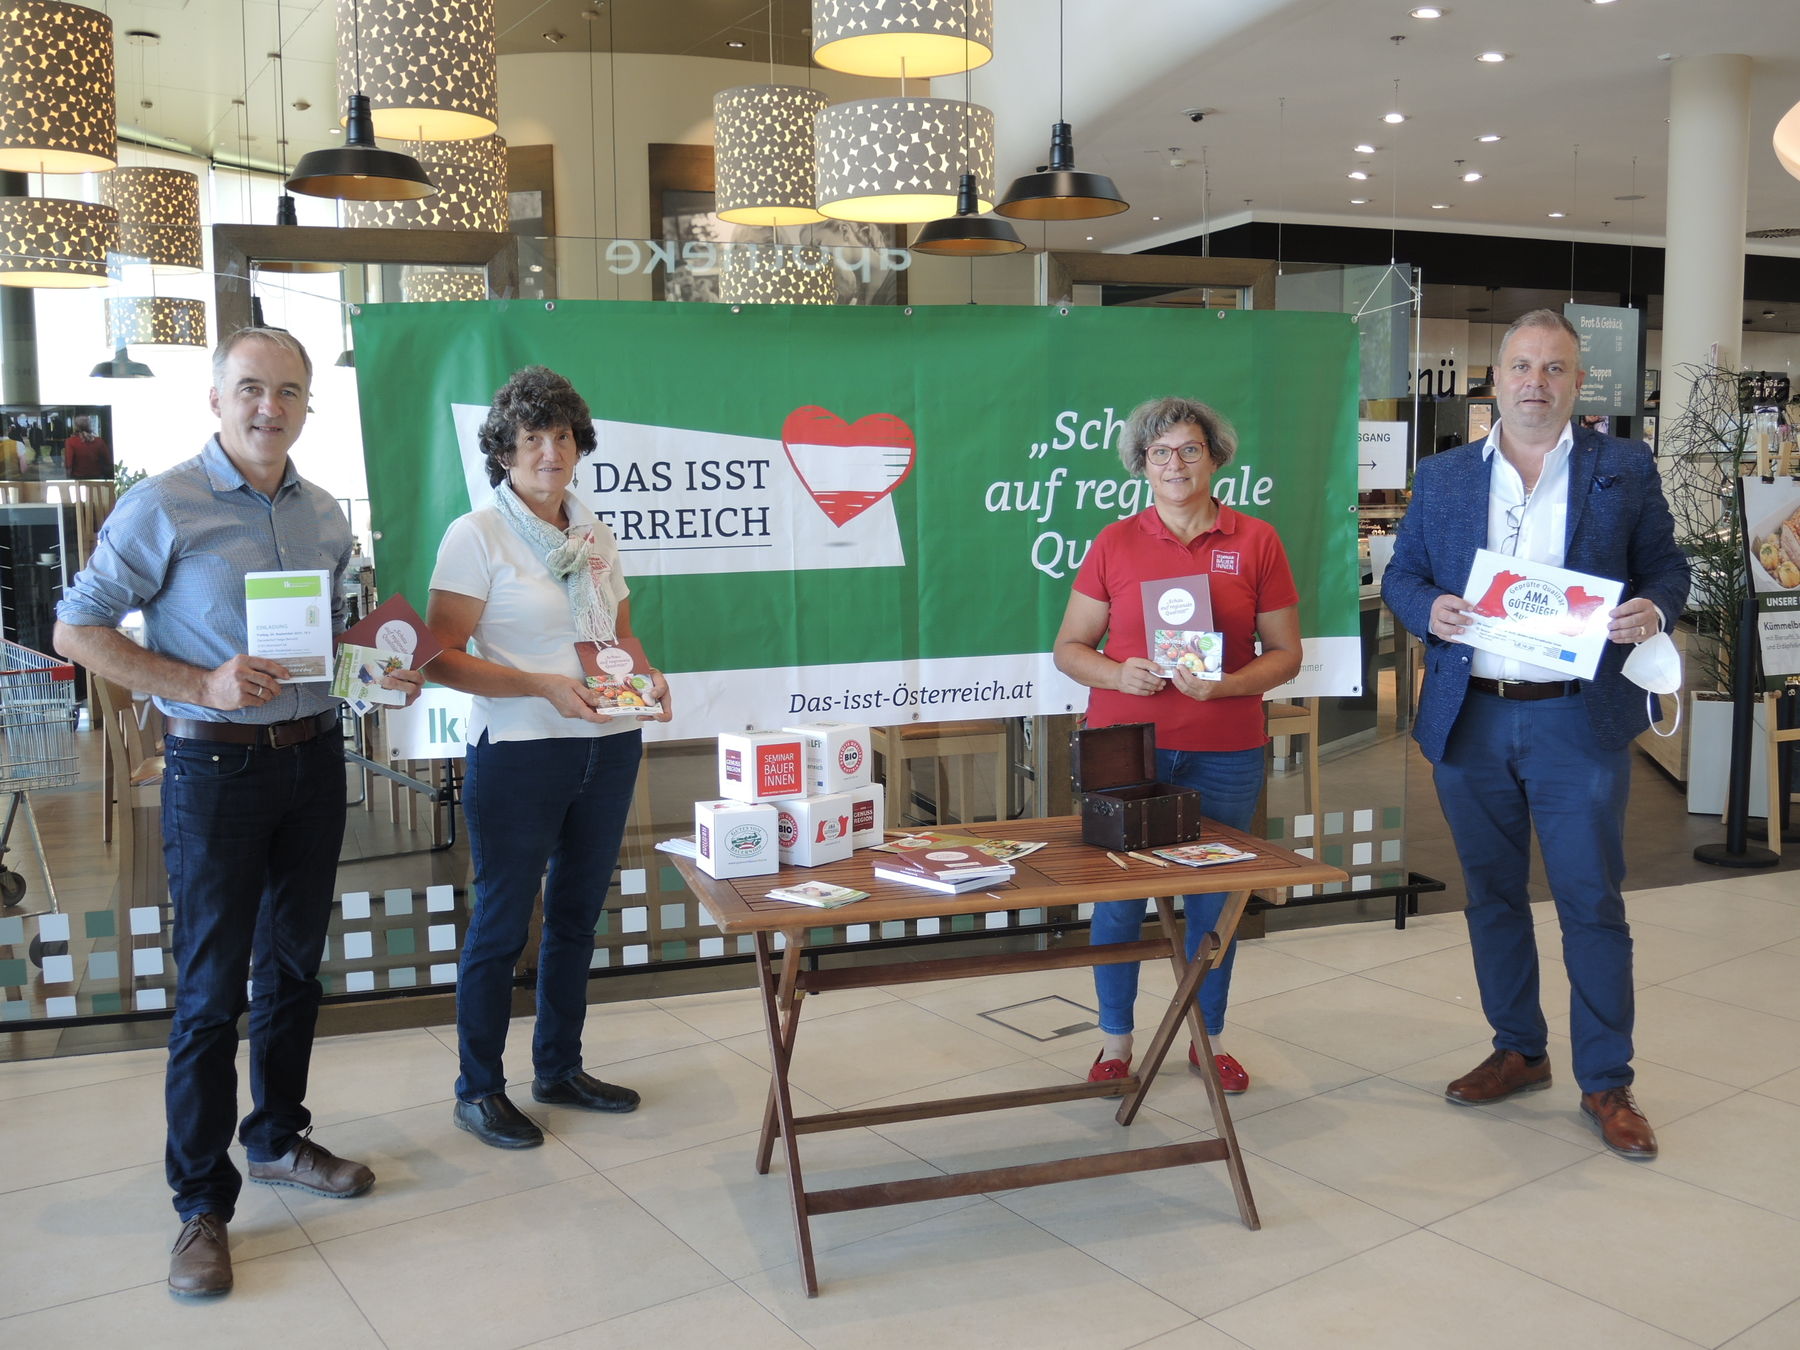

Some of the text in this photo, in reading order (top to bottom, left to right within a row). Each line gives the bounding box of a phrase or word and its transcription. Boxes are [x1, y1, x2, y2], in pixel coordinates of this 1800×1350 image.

[1590, 365, 1612, 381] Suppen
[592, 460, 770, 493] DAS ISST
[985, 466, 1273, 523] auf regiale
[1523, 590, 1549, 606] AMA
[1766, 597, 1798, 607] UNSERE
[788, 680, 1033, 714] Das-isst-Österreich.at
[764, 753, 794, 763] SEMINAR
[844, 752, 858, 761] BIO
[764, 774, 795, 787] INNEN
[854, 810, 872, 818] GENUSS
[854, 816, 872, 824] REGION
